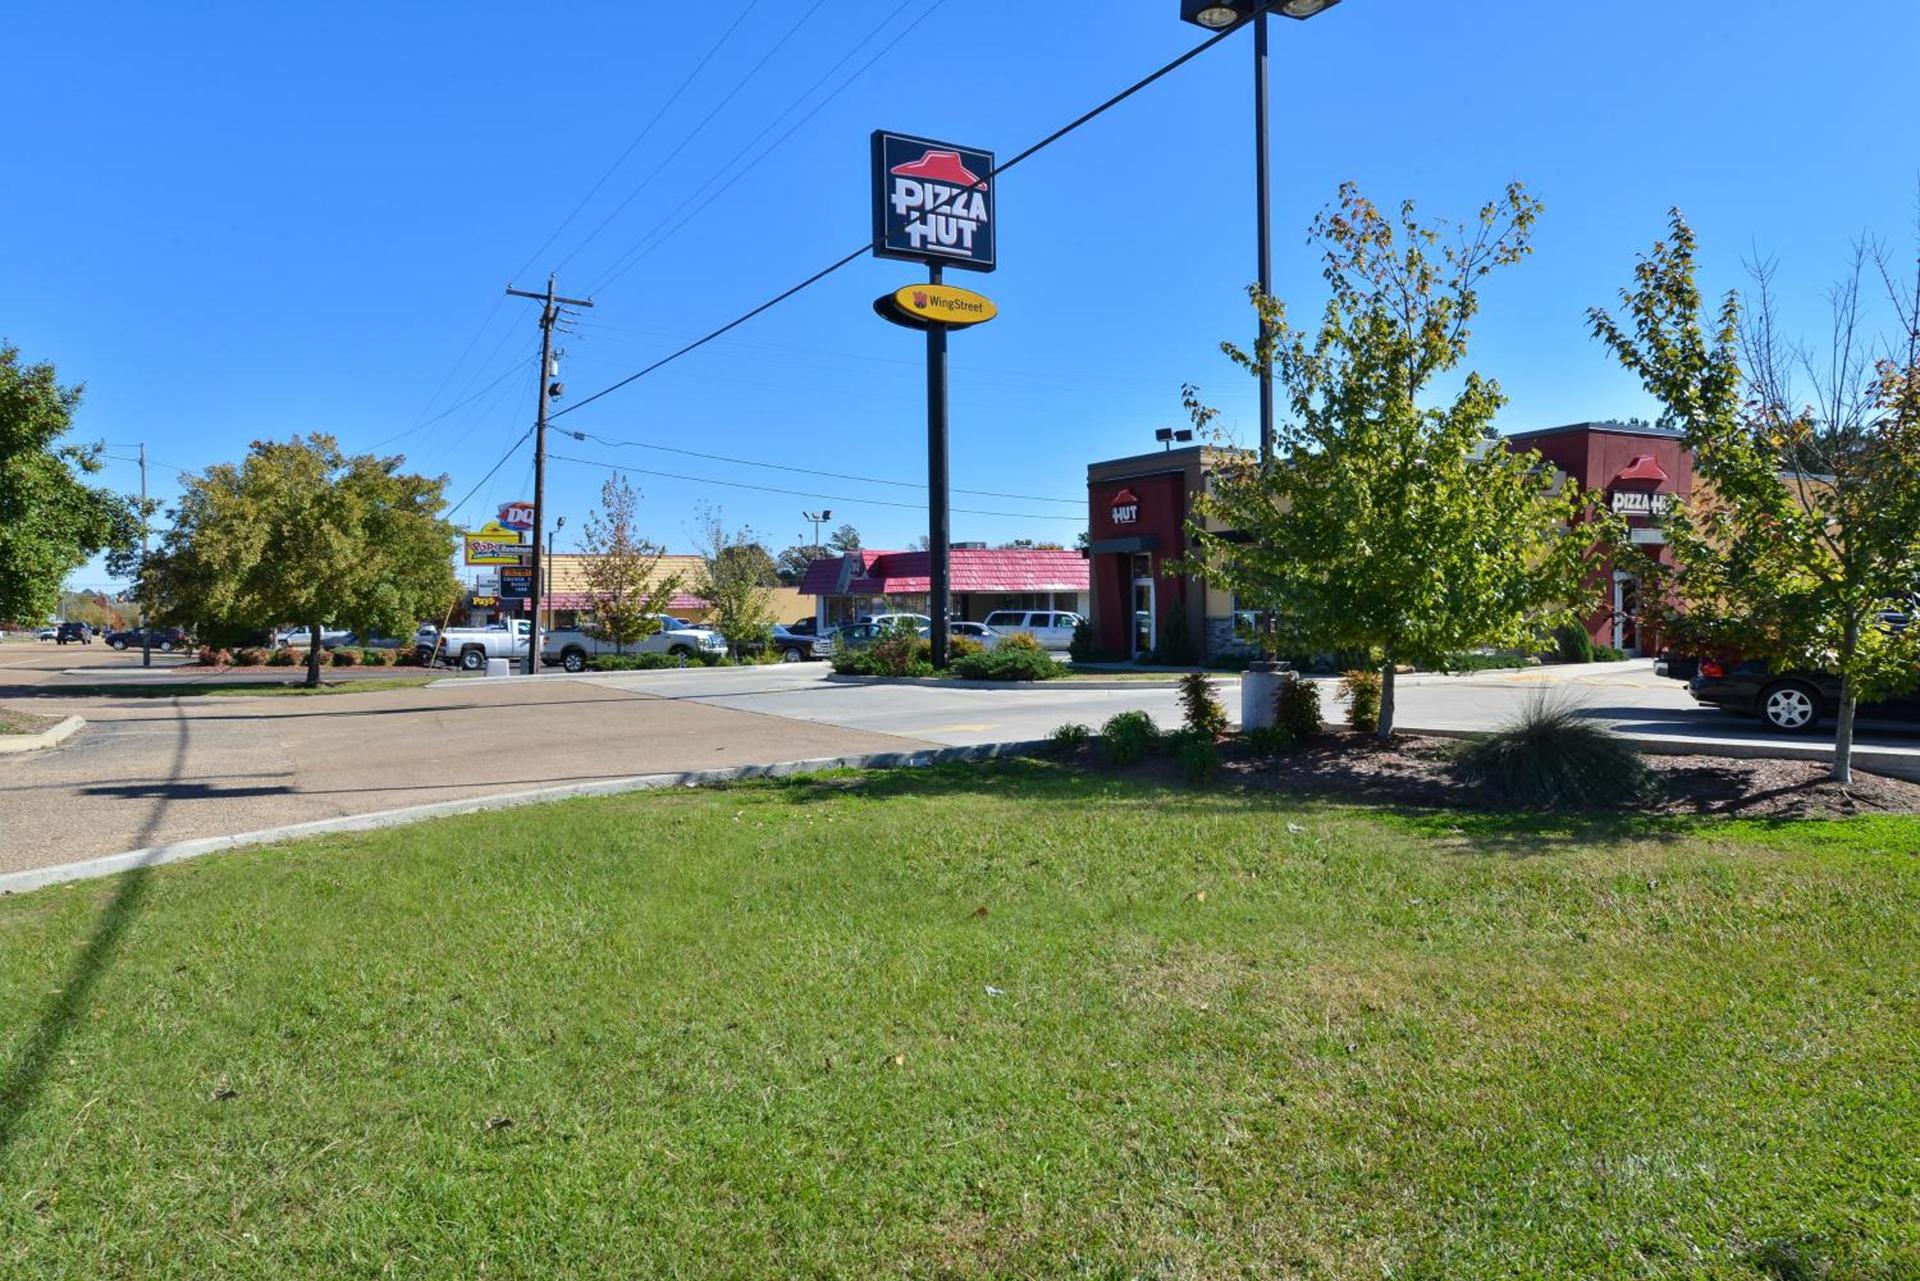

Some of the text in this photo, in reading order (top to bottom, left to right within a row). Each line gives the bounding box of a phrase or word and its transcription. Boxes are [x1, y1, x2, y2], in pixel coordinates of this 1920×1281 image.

[891, 178, 988, 222] PIZZA
[905, 211, 977, 248] HUT
[929, 295, 983, 313] WingStreet
[1612, 492, 1650, 513] PIZZA
[506, 508, 535, 524] DQ
[1112, 505, 1137, 524] HUT
